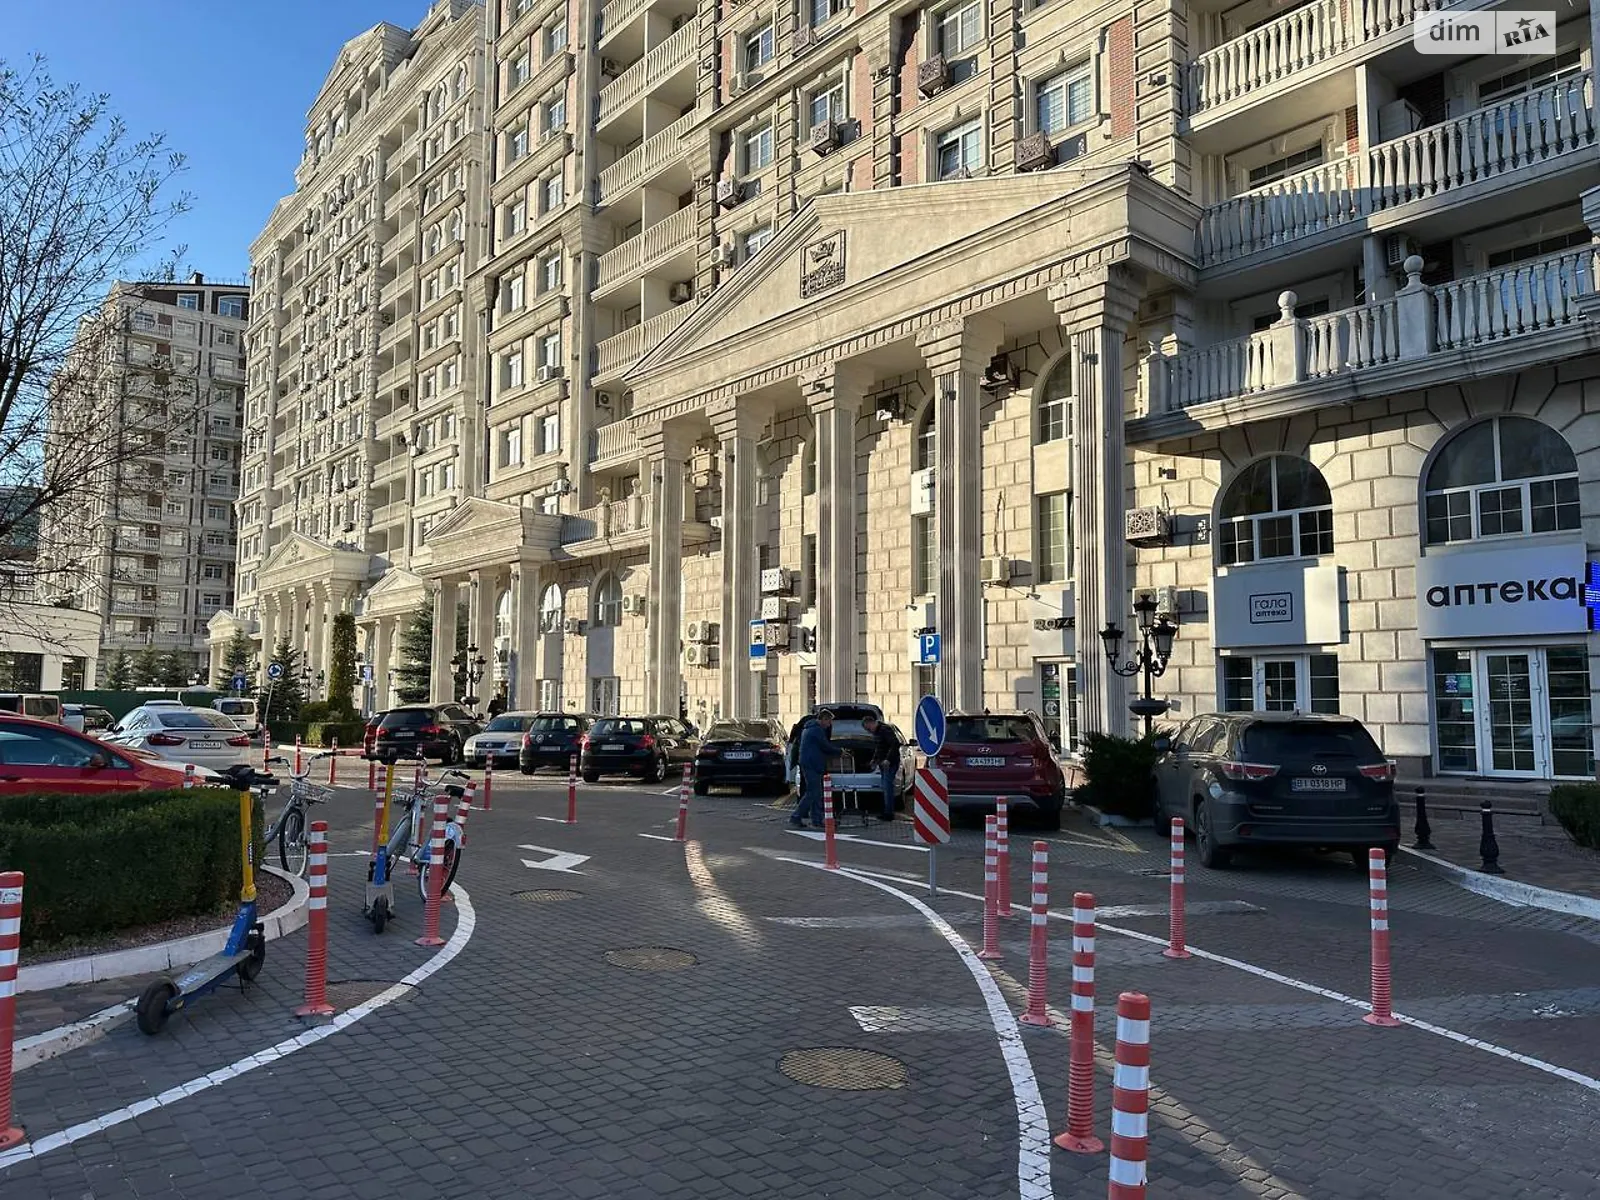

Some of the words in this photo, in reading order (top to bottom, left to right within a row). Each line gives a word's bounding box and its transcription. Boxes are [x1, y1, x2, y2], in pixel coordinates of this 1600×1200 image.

[1426, 576, 1577, 607] аптека
[1254, 598, 1287, 609] гала
[1255, 609, 1287, 617] аптека
[925, 635, 935, 654] P
